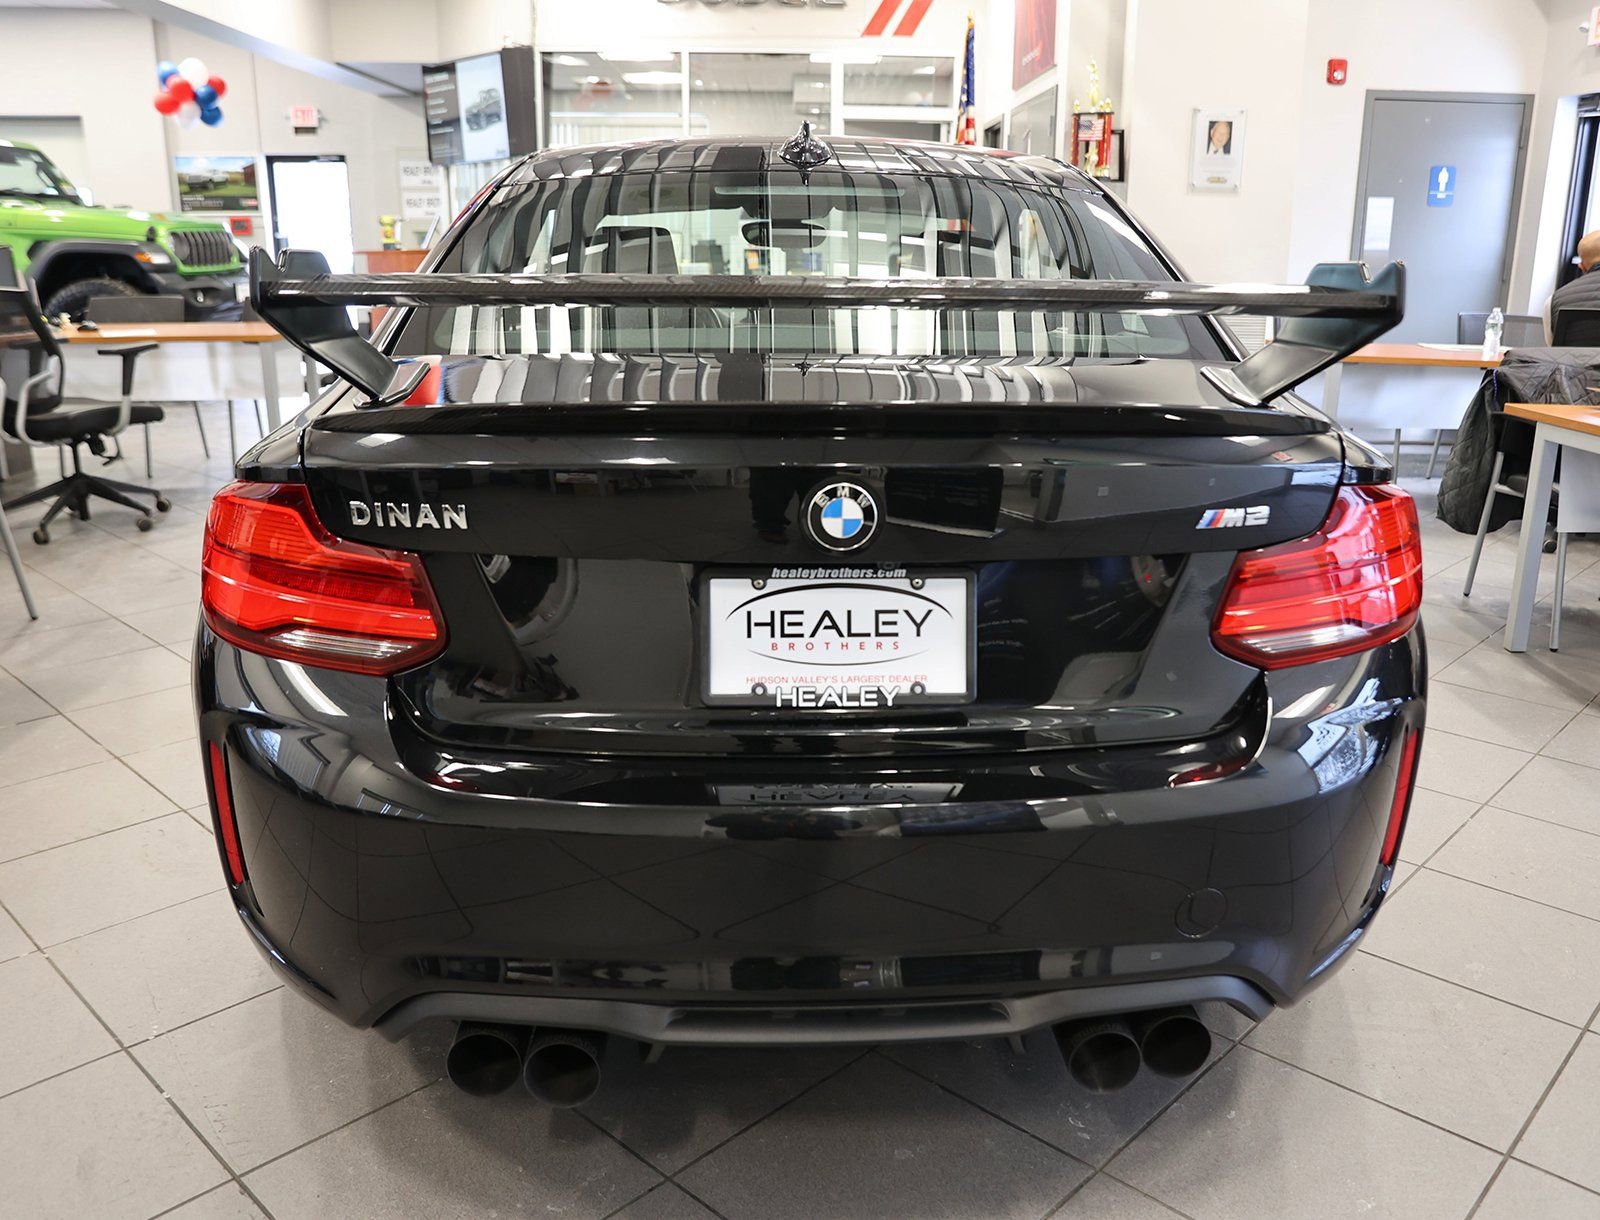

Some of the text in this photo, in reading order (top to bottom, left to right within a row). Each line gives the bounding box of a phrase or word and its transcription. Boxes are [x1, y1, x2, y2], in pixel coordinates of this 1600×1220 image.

[815, 485, 872, 509] BMW
[349, 501, 468, 529] DINAN
[1213, 505, 1270, 529] M2
[771, 567, 907, 580] healeybrothers.com
[746, 609, 933, 638] HEALEY
[771, 641, 900, 651] BROTHERS
[746, 674, 928, 684] HUDSON VALLEY'S LARGEST DEALER
[775, 685, 901, 708] HEALEY
